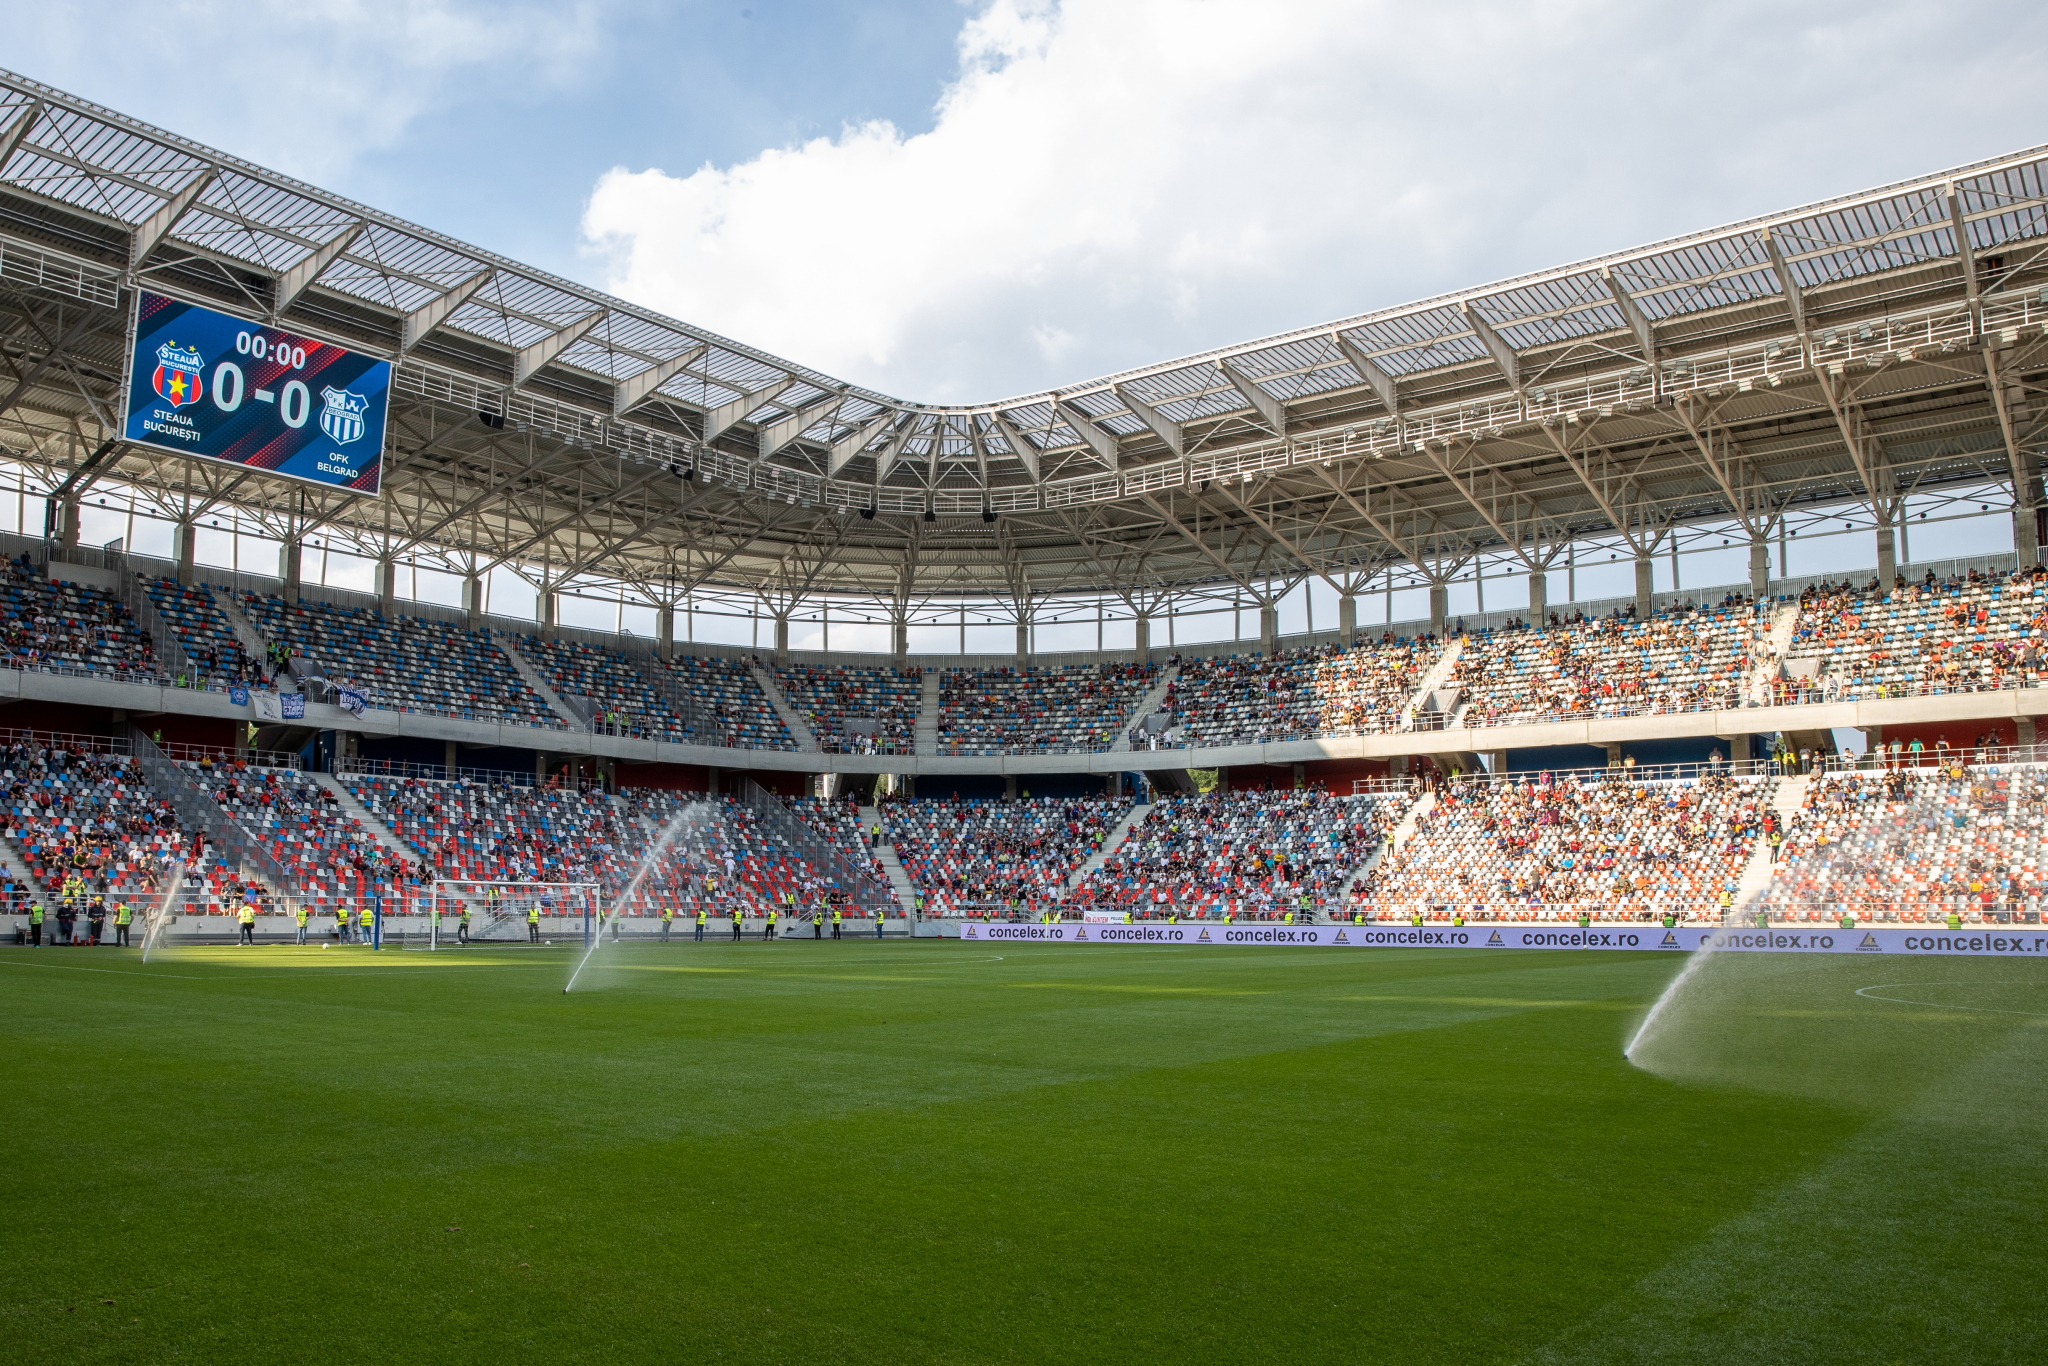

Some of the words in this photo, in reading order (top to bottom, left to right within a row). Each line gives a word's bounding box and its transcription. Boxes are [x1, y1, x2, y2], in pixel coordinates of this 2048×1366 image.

[161, 347, 200, 367] STEAUA
[236, 331, 306, 369] 00:00
[153, 409, 194, 426] STEAUA
[328, 408, 359, 420] BEOGRAD
[329, 452, 349, 465] OFK
[317, 461, 359, 478] BELGRAD
[989, 926, 1063, 939] concelex.ro
[1100, 927, 1184, 940] concelex.ro
[1225, 928, 1318, 943] concelex.ro
[1365, 929, 1469, 944] concelex.ro
[1522, 930, 1639, 946] concelex.ro
[1700, 931, 1834, 949] concelex.ro
[1904, 933, 2048, 952] concelex.r
